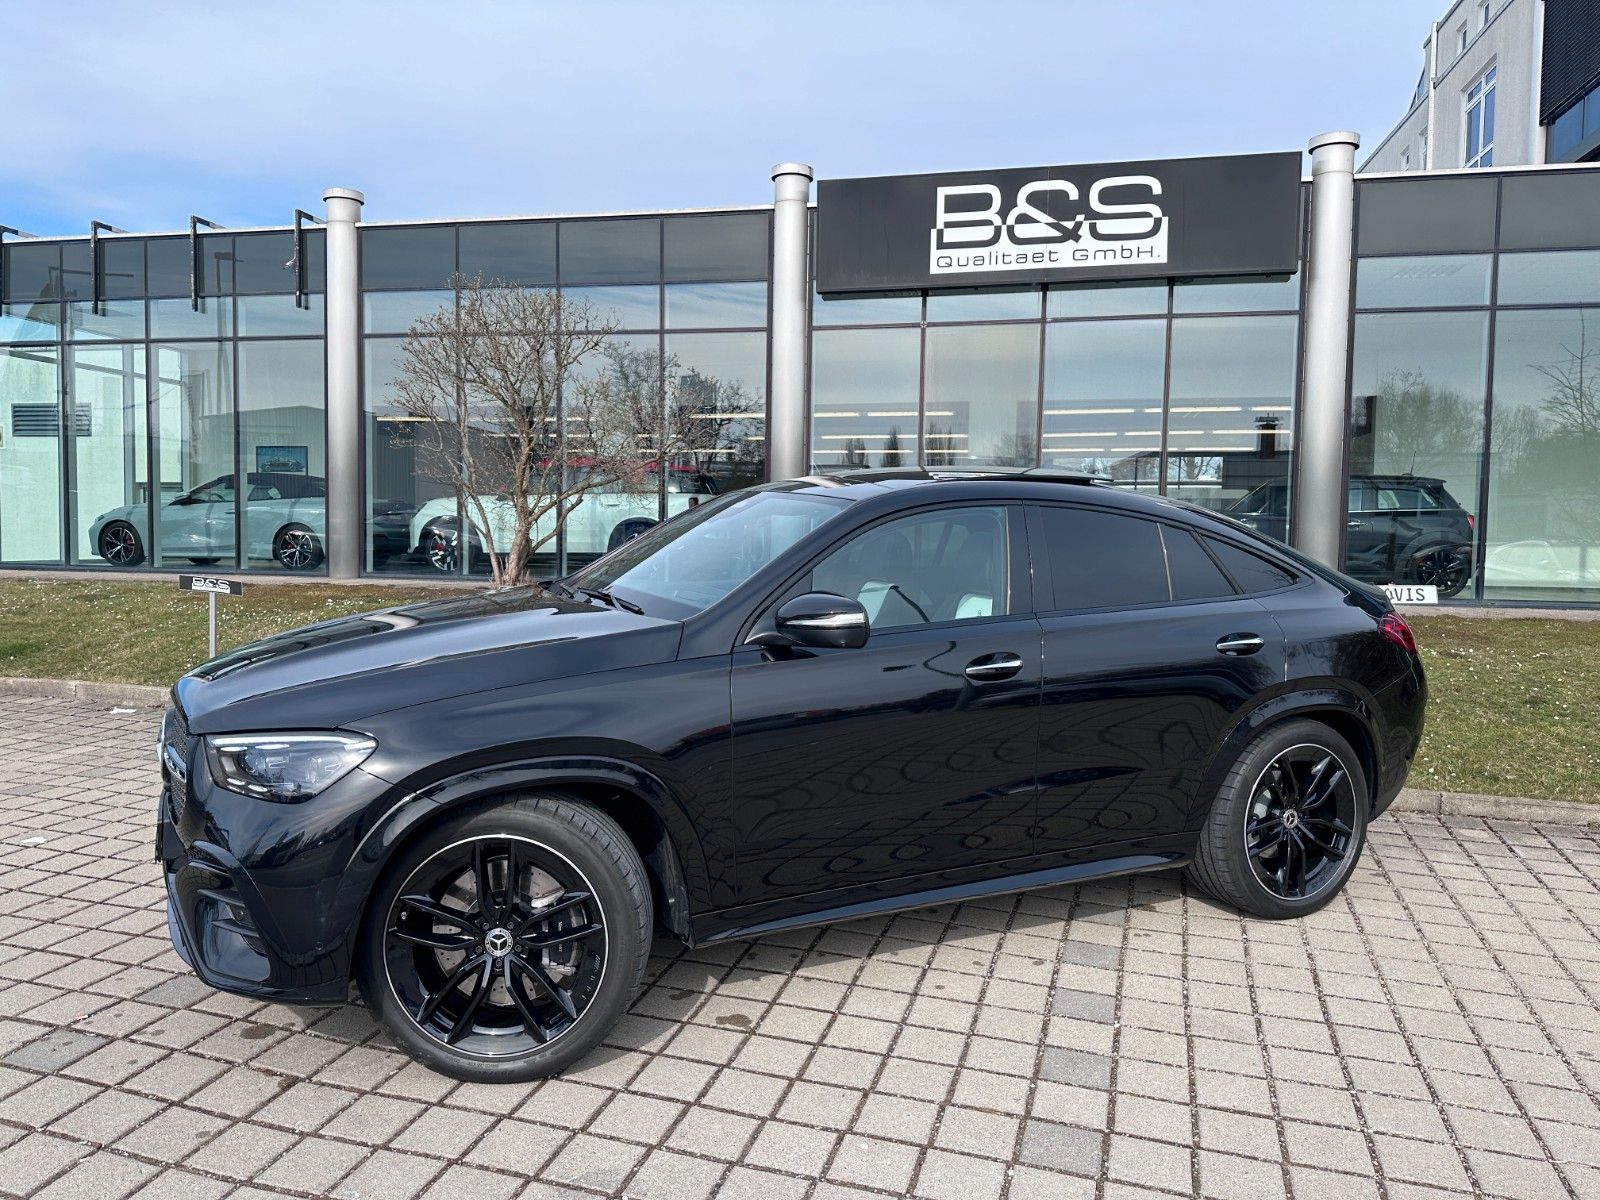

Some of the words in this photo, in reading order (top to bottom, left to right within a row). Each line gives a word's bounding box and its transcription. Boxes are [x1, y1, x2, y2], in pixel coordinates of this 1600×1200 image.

[936, 175, 1163, 250] B&S
[936, 249, 1059, 268] Qualitaet
[1072, 245, 1161, 261] GmbH.
[192, 576, 230, 590] B&S
